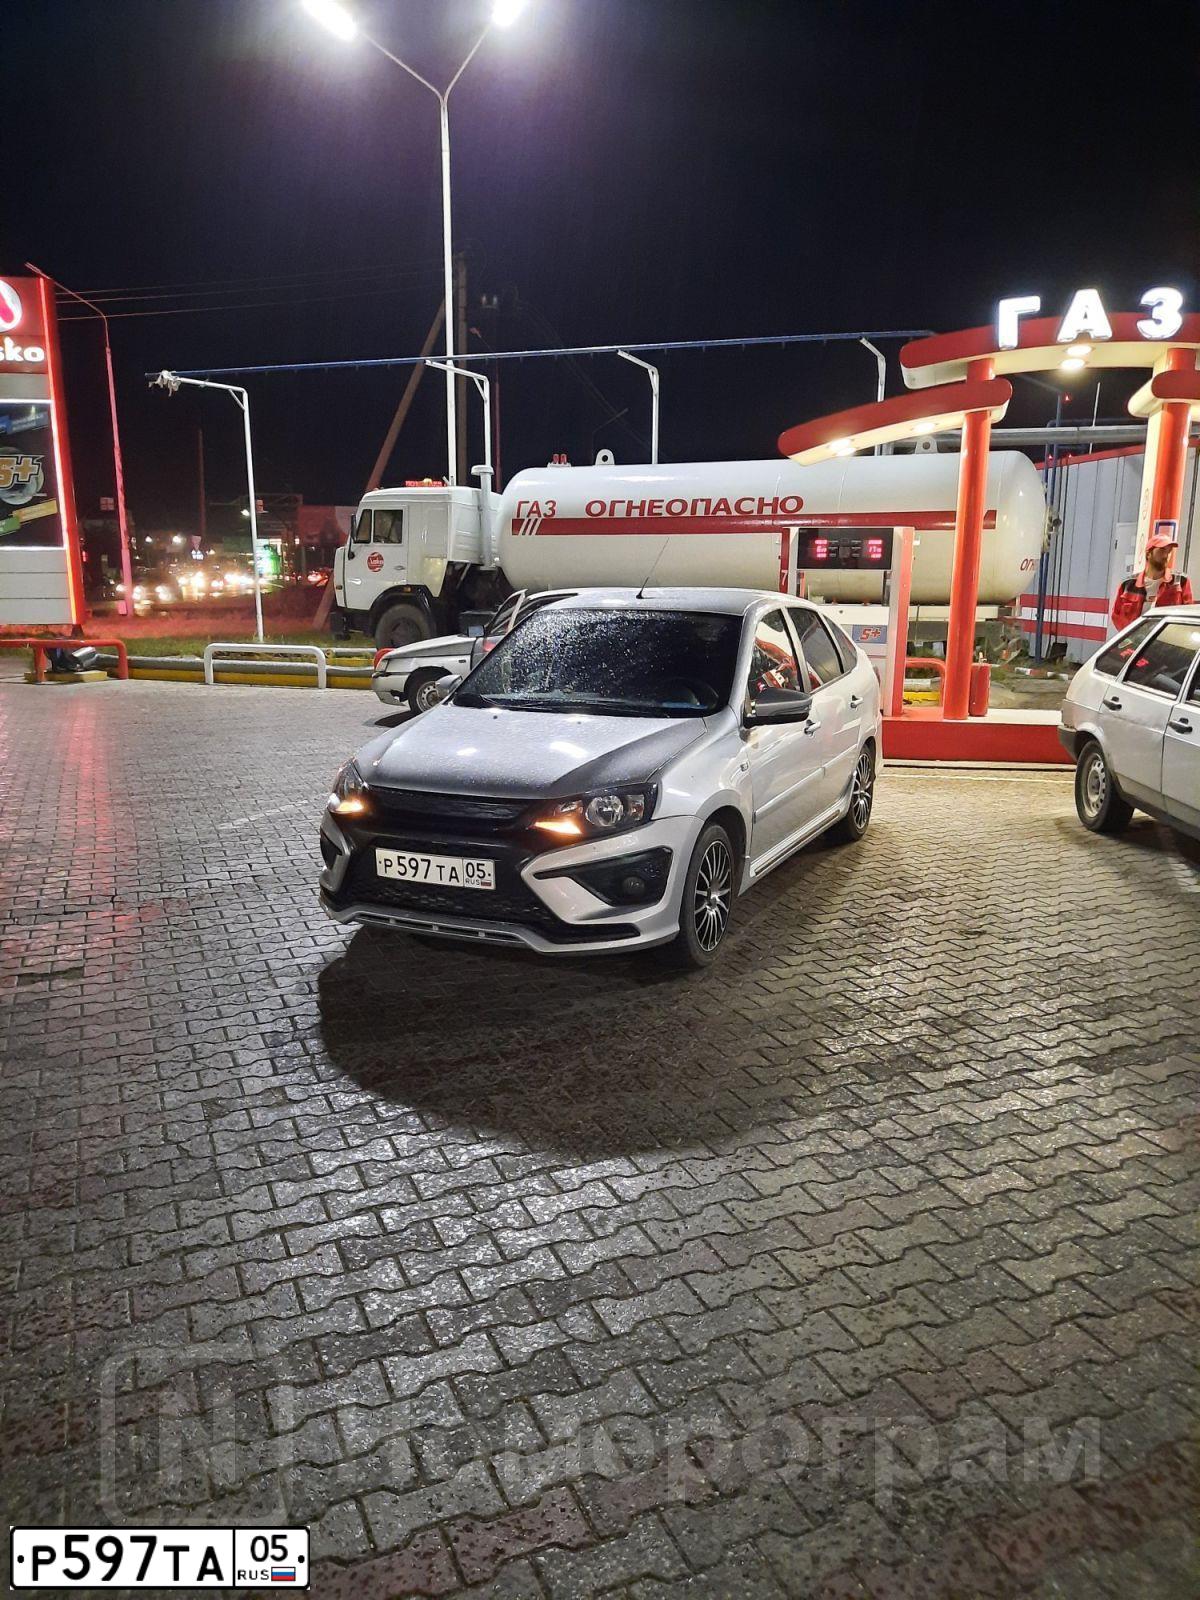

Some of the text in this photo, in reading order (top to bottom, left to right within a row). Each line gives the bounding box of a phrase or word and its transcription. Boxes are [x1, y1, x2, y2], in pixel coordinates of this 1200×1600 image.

[998, 286, 1183, 350] ГАЗ
[0, 336, 45, 362] ko
[516, 495, 804, 518] ГАЗ ОГНЕОПАСНО
[383, 855, 487, 883] Р597ТА 05
